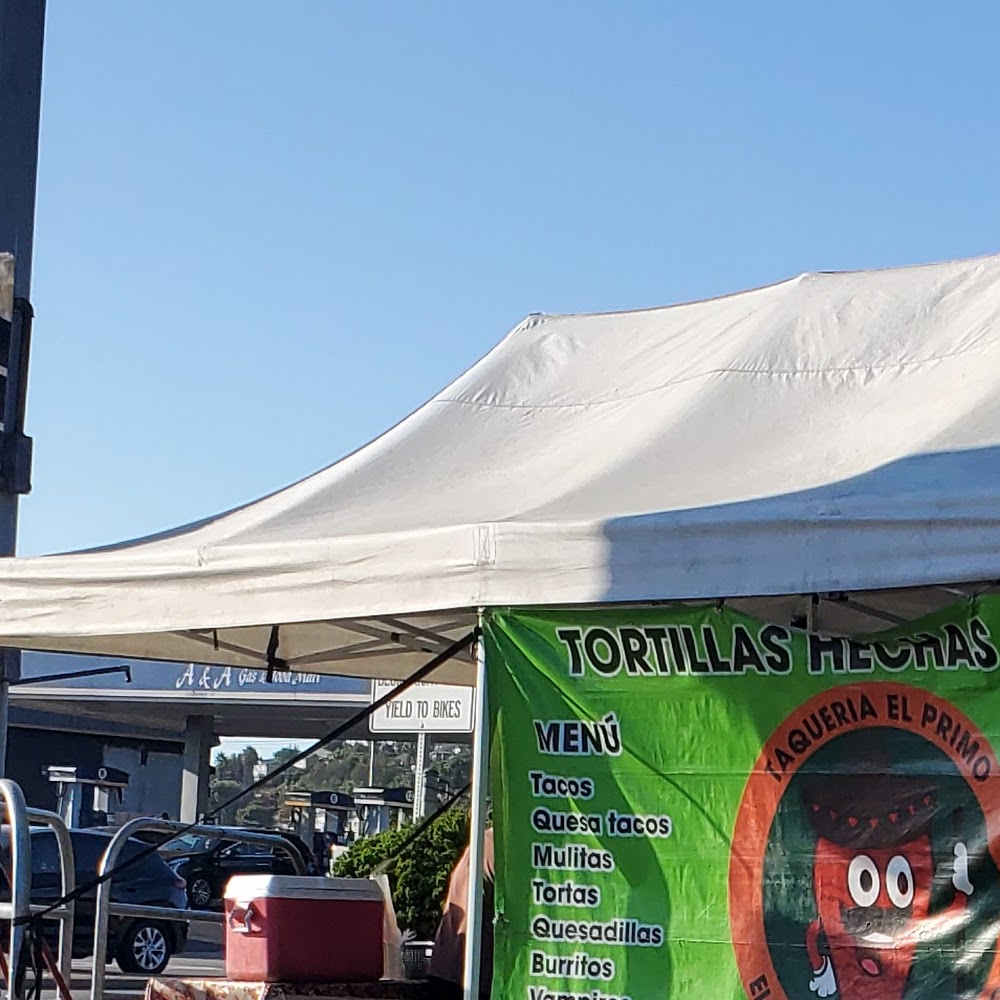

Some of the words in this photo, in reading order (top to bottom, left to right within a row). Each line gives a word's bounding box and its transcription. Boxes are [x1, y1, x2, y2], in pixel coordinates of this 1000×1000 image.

[557, 625, 790, 676] TORTILLAS
[176, 663, 195, 689] A
[199, 666, 211, 689] &
[214, 666, 231, 689] A
[238, 668, 258, 687] Gas
[385, 700, 413, 718] YIELD
[417, 700, 428, 718] TO
[433, 700, 462, 718] BIKES
[534, 714, 622, 754] MENÚ
[764, 693, 878, 782] TAQUERIA
[886, 694, 912, 722] EL
[920, 702, 991, 782] PRIMO
[530, 772, 593, 797] Tacos
[532, 808, 601, 833] Quesa
[607, 811, 670, 835] tacos
[533, 845, 613, 869] Mulitas
[532, 880, 599, 905] Tortas
[532, 917, 663, 944] Quesadillas
[531, 952, 613, 978] Burritos
